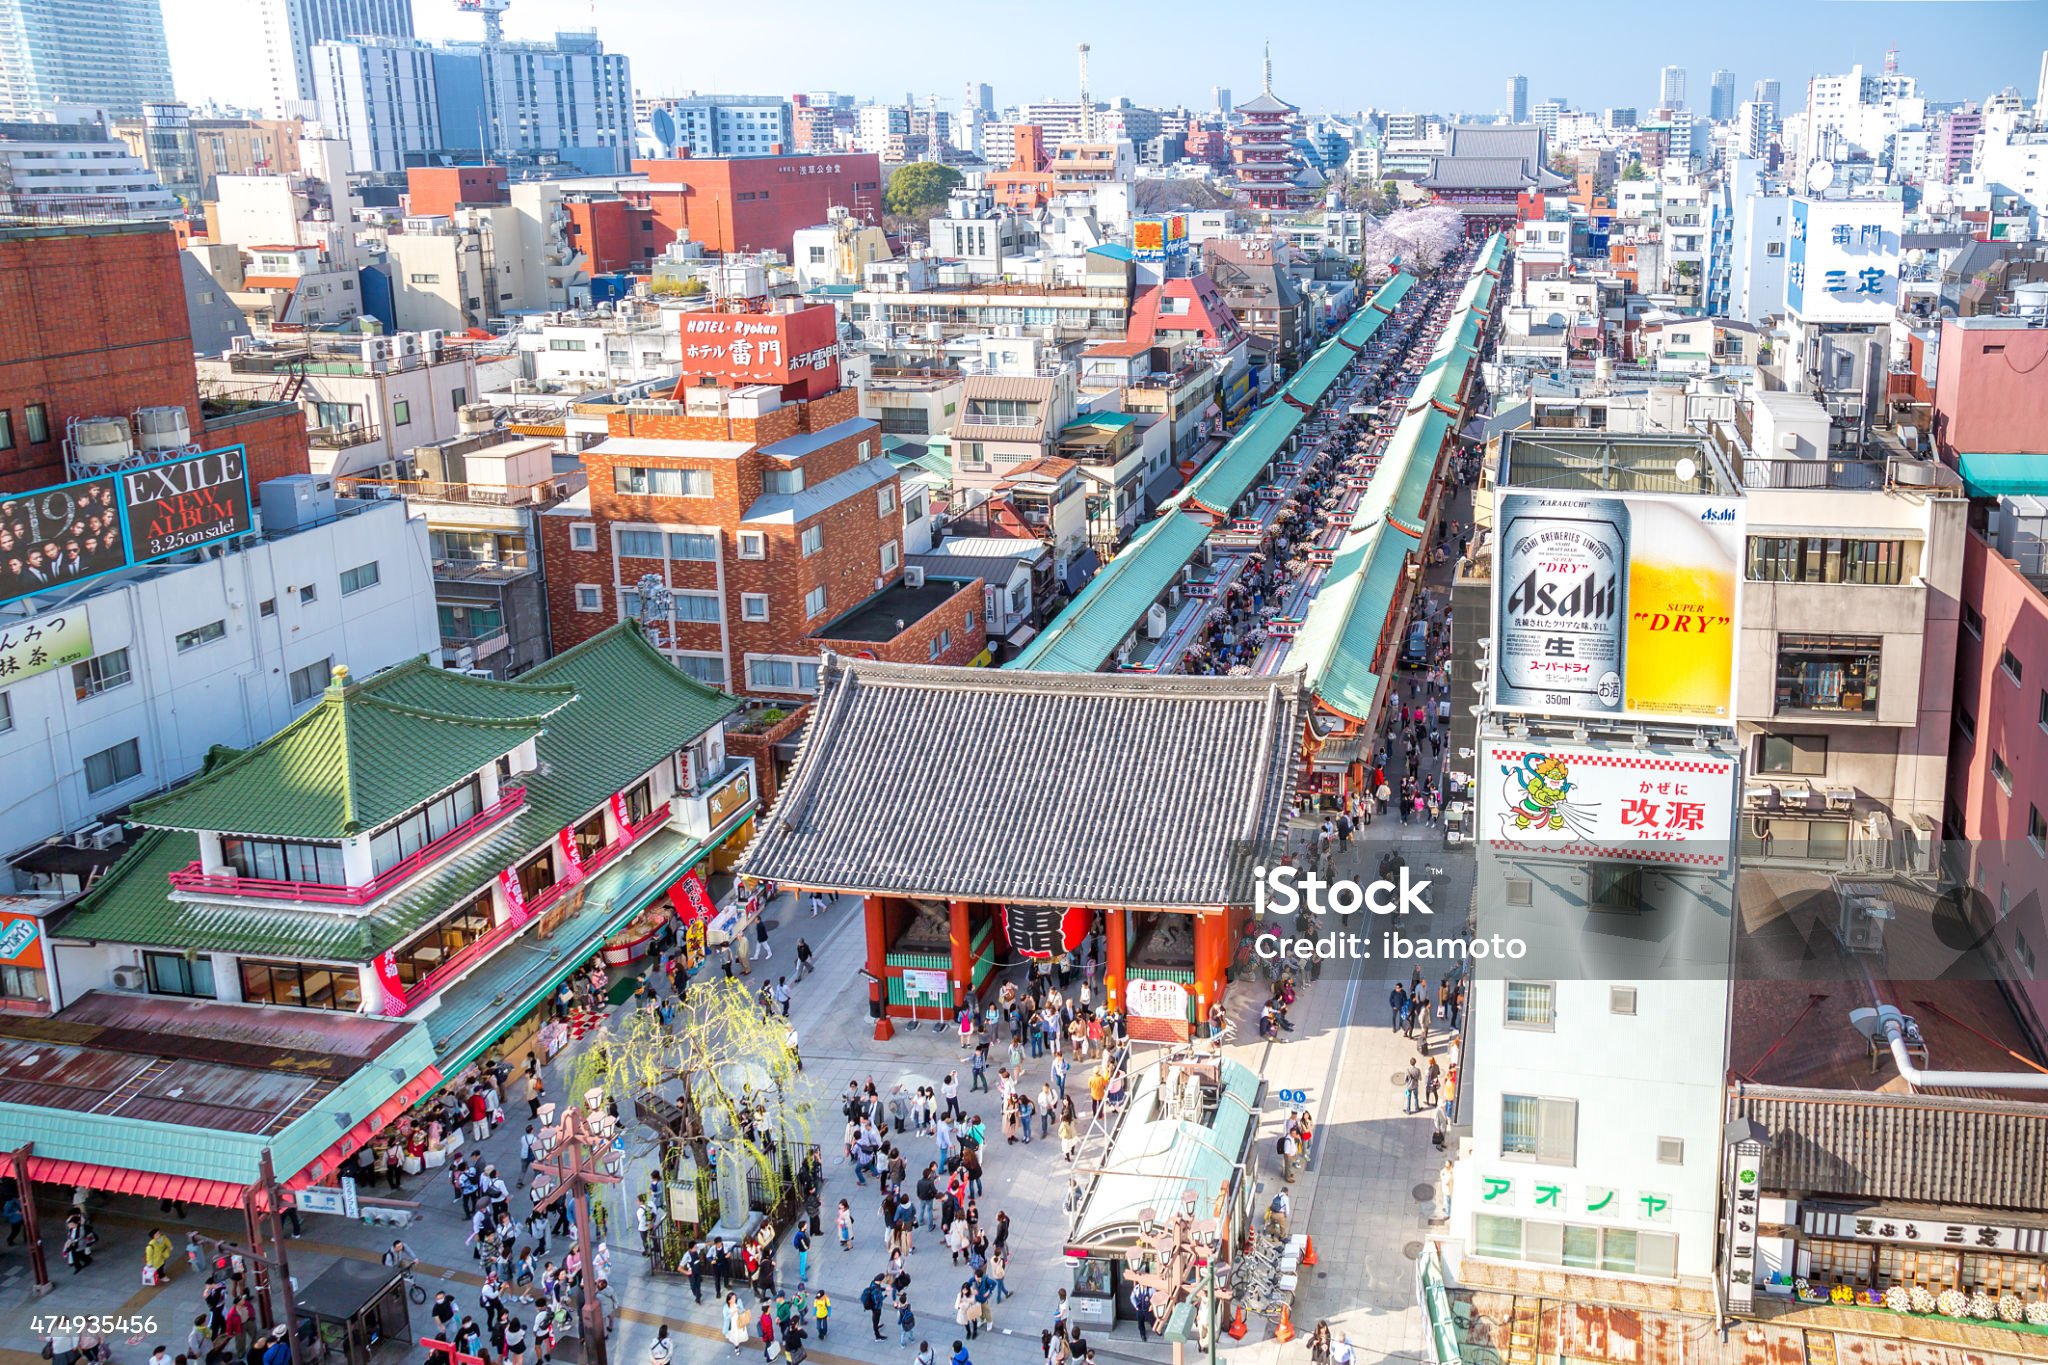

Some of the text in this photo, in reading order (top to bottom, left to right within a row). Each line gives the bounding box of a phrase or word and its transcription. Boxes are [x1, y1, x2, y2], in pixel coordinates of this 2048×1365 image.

[1831, 224, 1882, 245] 雷門
[1824, 267, 1885, 294] 三定
[734, 321, 778, 335] Ryokan
[124, 450, 243, 507] EXILE
[157, 486, 219, 518] NEW
[146, 500, 234, 539] ALBUM
[1701, 508, 1736, 521] Asahi
[205, 519, 235, 539] sale!
[1521, 531, 1606, 560] ASAHI BREWERIES LIMITED
[1508, 569, 1616, 620] Asahi
[1667, 602, 1704, 614] SUPER
[1545, 637, 1575, 657] 生
[1530, 660, 1591, 673] スーパードライ
[1545, 694, 1571, 705] 350ml
[1599, 681, 1620, 699] お酒
[1640, 781, 1688, 796] かぜに
[1621, 798, 1705, 830] 改源
[1638, 830, 1686, 841] カイゲン
[1738, 1189, 1755, 1232] 天ぷら
[1855, 1219, 1917, 1240] 天ぷら
